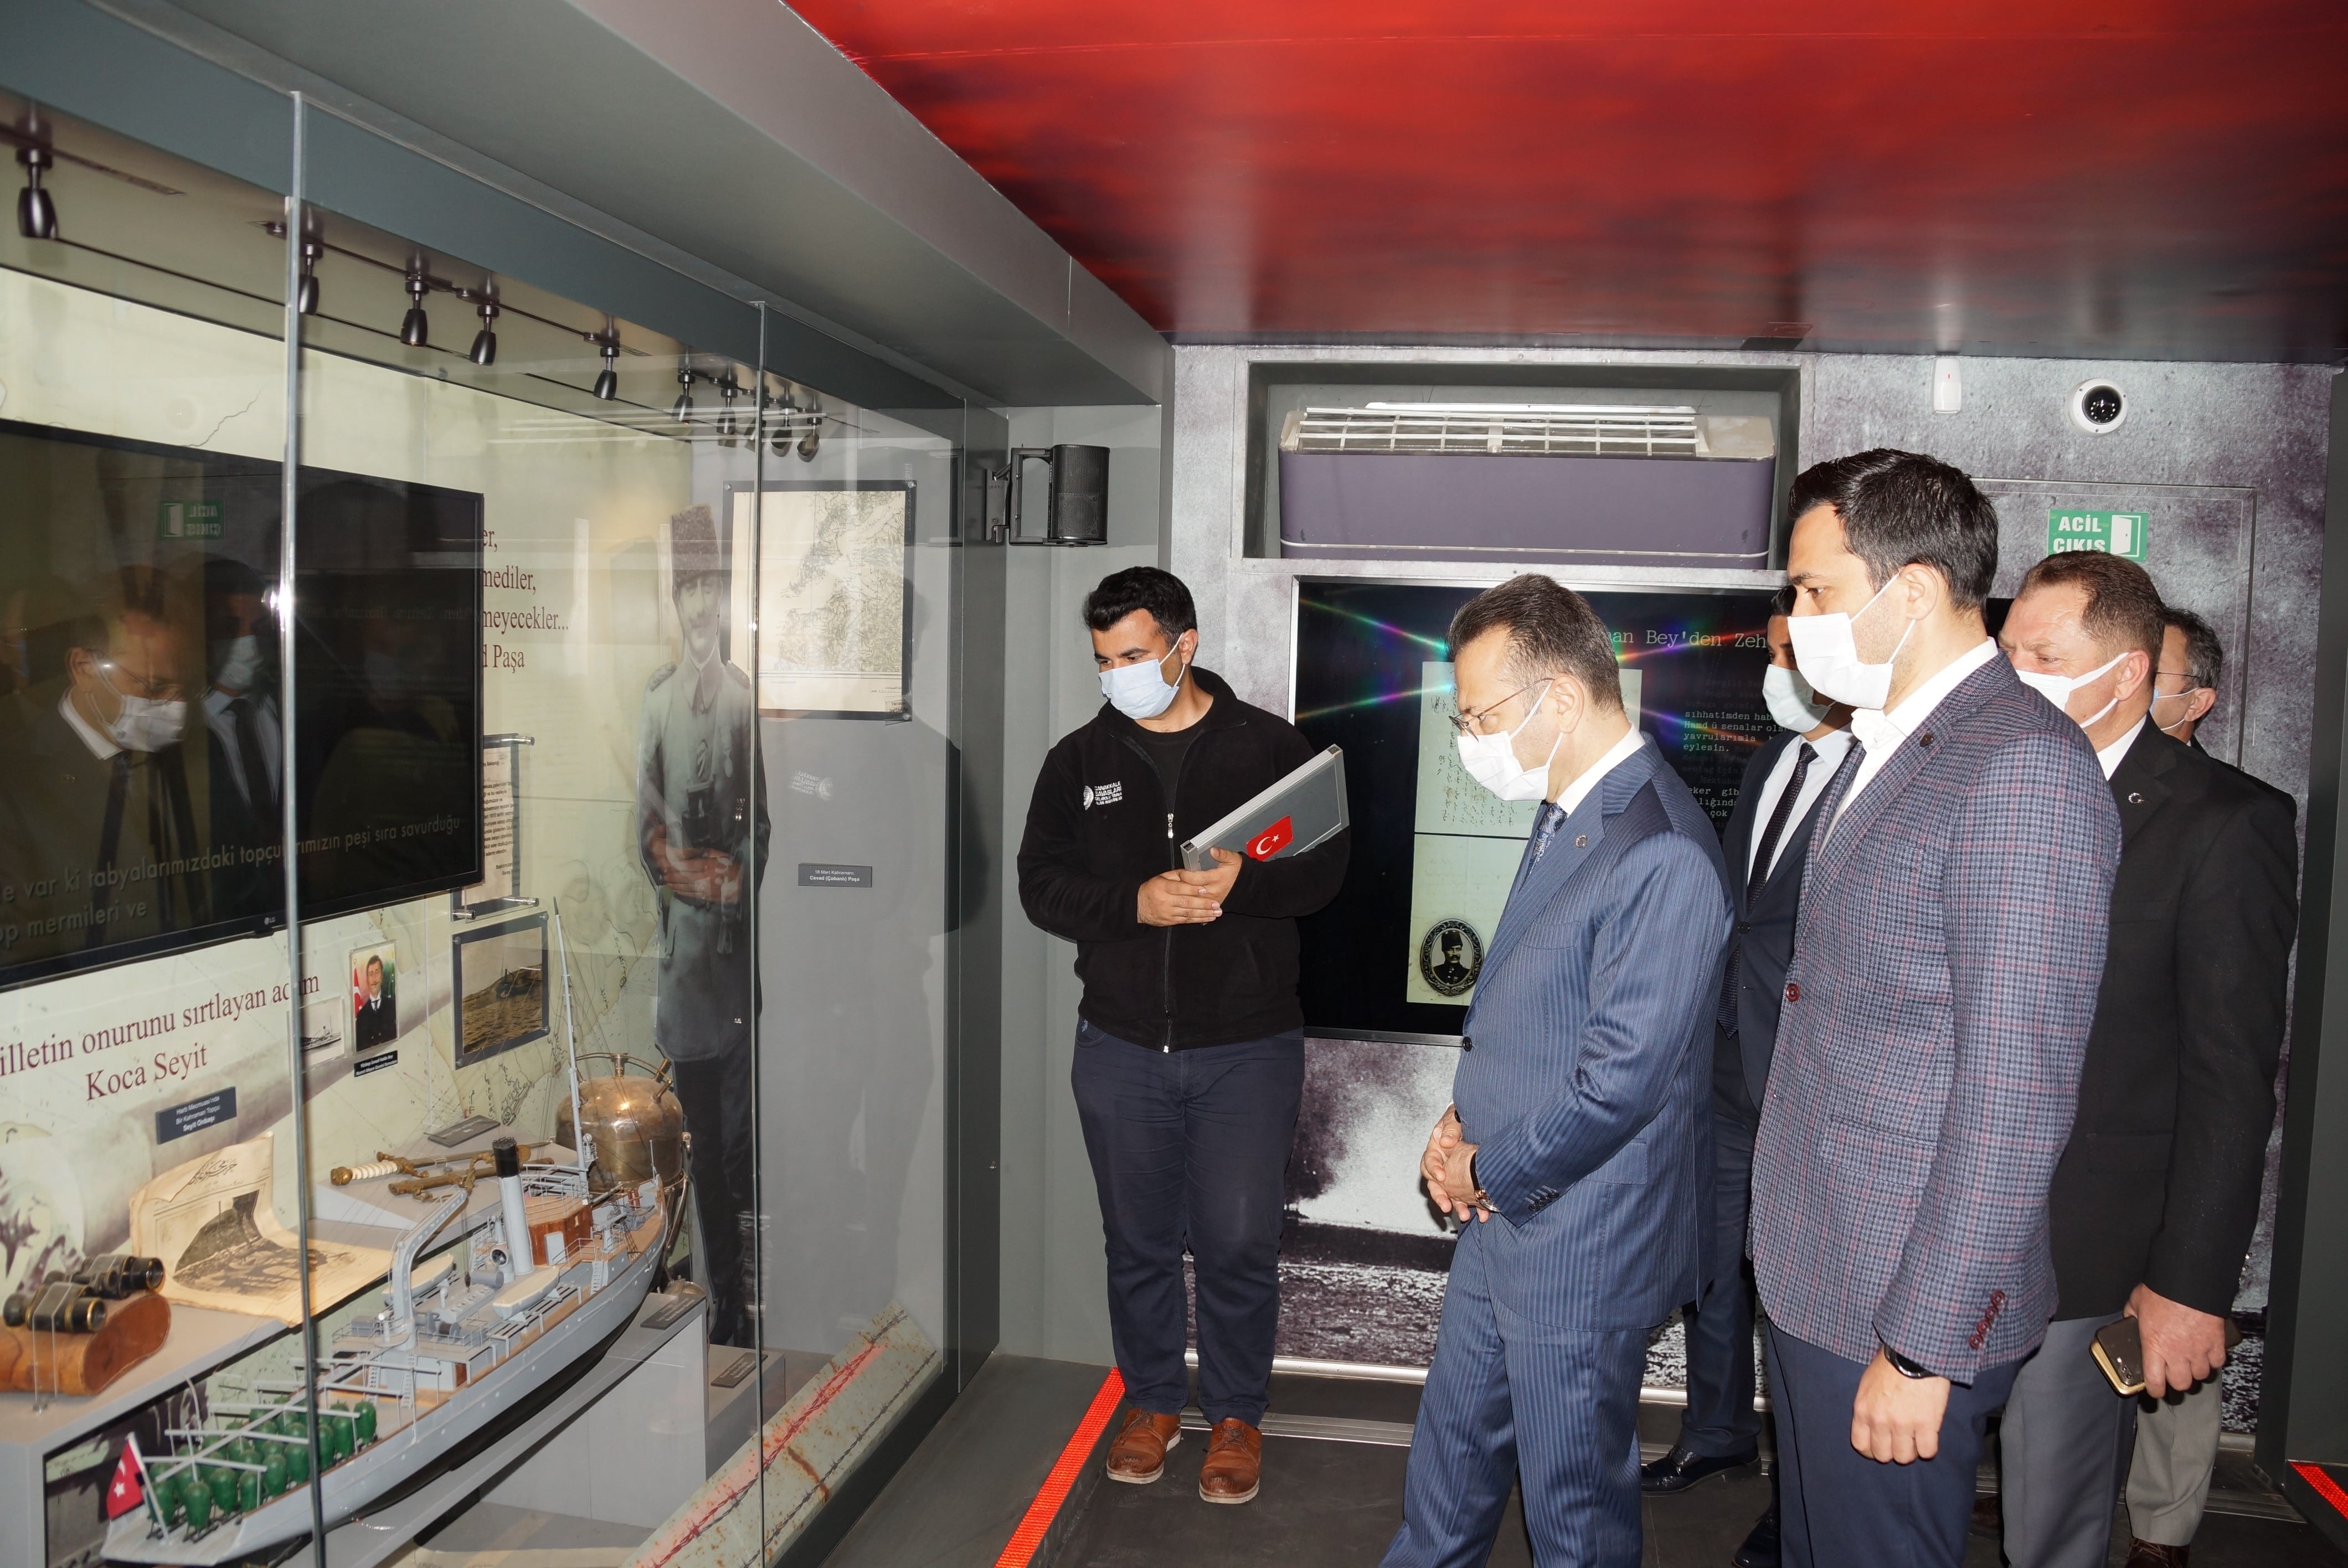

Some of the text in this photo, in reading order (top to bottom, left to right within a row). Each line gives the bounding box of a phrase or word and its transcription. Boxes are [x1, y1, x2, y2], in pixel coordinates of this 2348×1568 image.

[2058, 514, 2102, 532] ACİL
[483, 565, 536, 595] mediler,
[483, 606, 569, 635] meyecekler...
[1646, 630, 1722, 647] Bey'den
[1734, 633, 1768, 648] Zeh
[492, 644, 525, 674] Paşa
[1685, 710, 1772, 721] sıhhatimden hab
[1684, 721, 1708, 729] Hamd
[1721, 723, 1763, 731] senalar
[1683, 731, 1757, 742] yavrularımla
[1683, 743, 1729, 752] eylesin.
[1696, 797, 1737, 808] lığınd
[1710, 809, 1728, 818] çok
[24, 879, 58, 899] var
[64, 869, 80, 894] ki
[89, 845, 235, 890] tabyalarımızdaki
[240, 834, 341, 868] topçurımızın
[345, 826, 372, 853] peşi
[375, 826, 397, 842] sıra
[401, 814, 461, 838] savurduğu
[28, 901, 120, 938] mermileri
[127, 901, 147, 919] ve
[0, 976, 320, 1077] illetin onurunu sırtlayan am
[86, 1042, 208, 1101] Koca Seyit
[183, 1110, 206, 1122] Kahraman
[183, 1116, 215, 1132] Seyit Onbaşı
